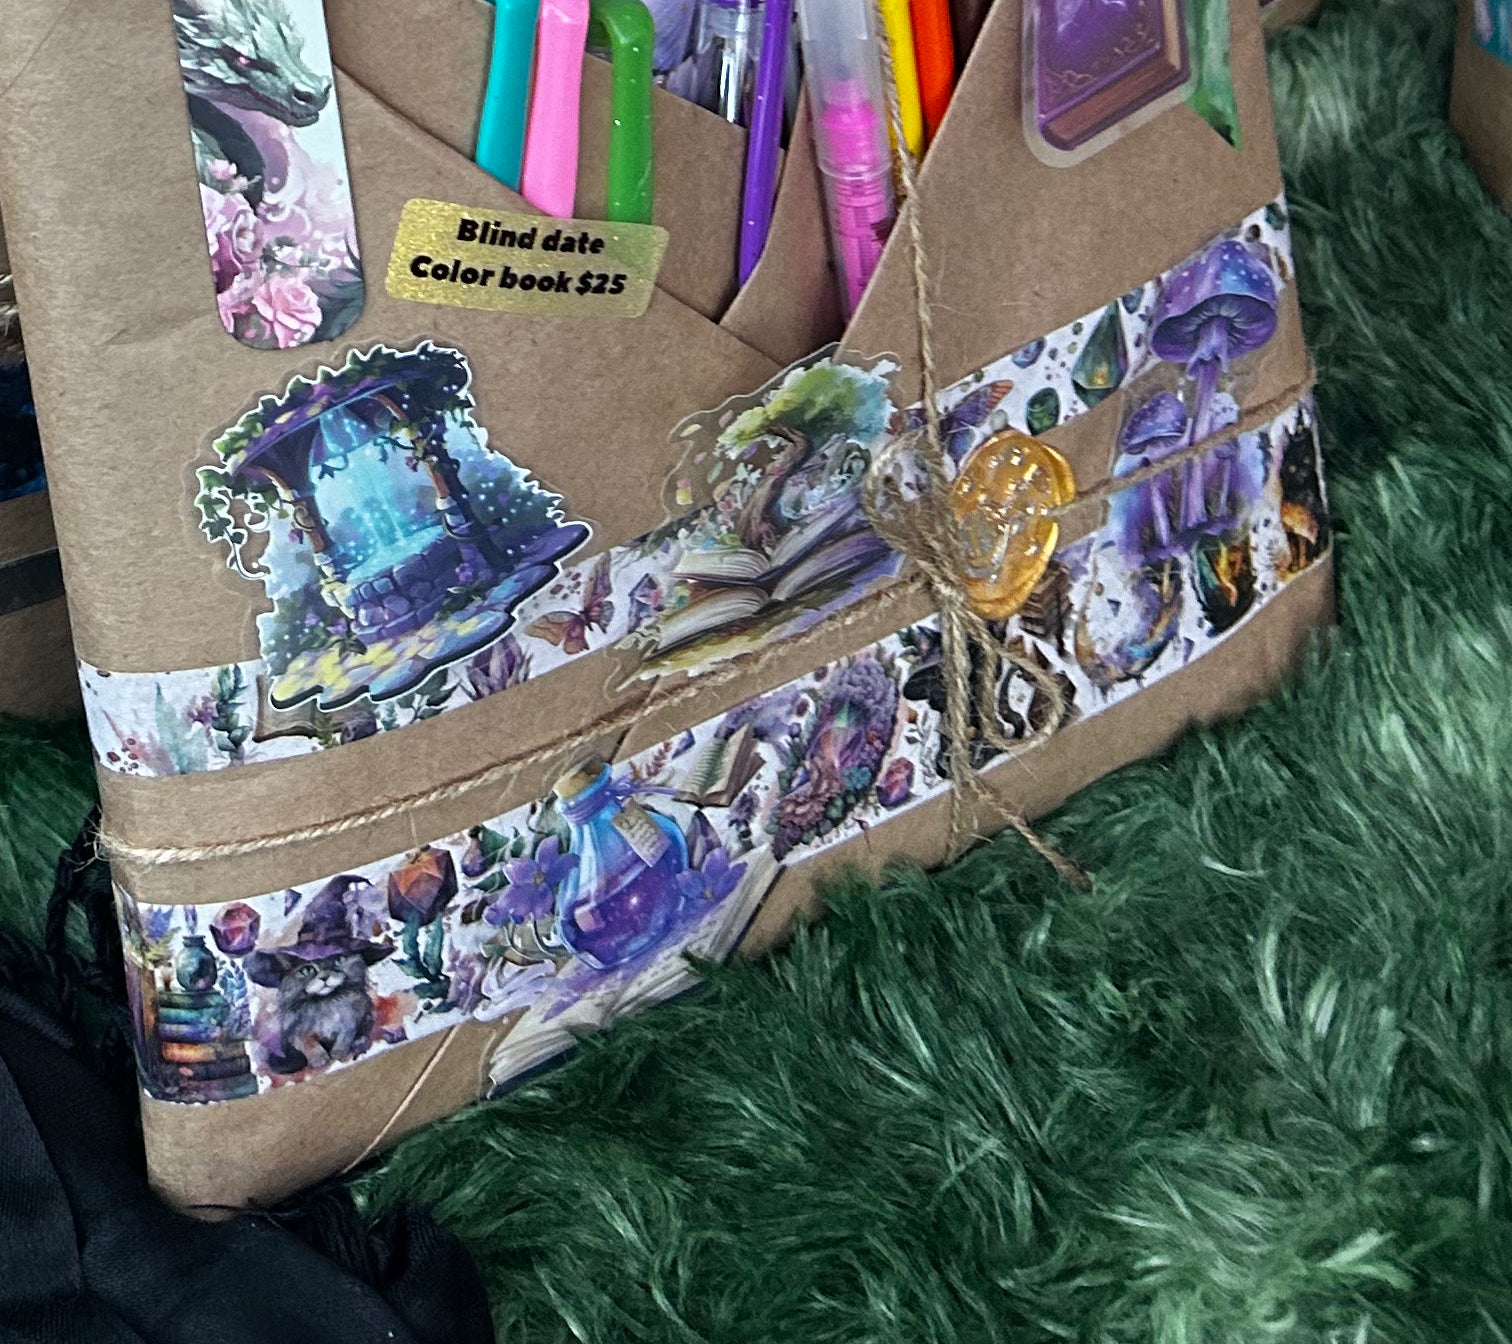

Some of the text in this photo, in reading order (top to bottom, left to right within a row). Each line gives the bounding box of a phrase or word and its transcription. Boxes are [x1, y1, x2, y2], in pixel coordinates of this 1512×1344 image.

[457, 218, 605, 254] Blind date
[410, 255, 627, 296] Color book $25
